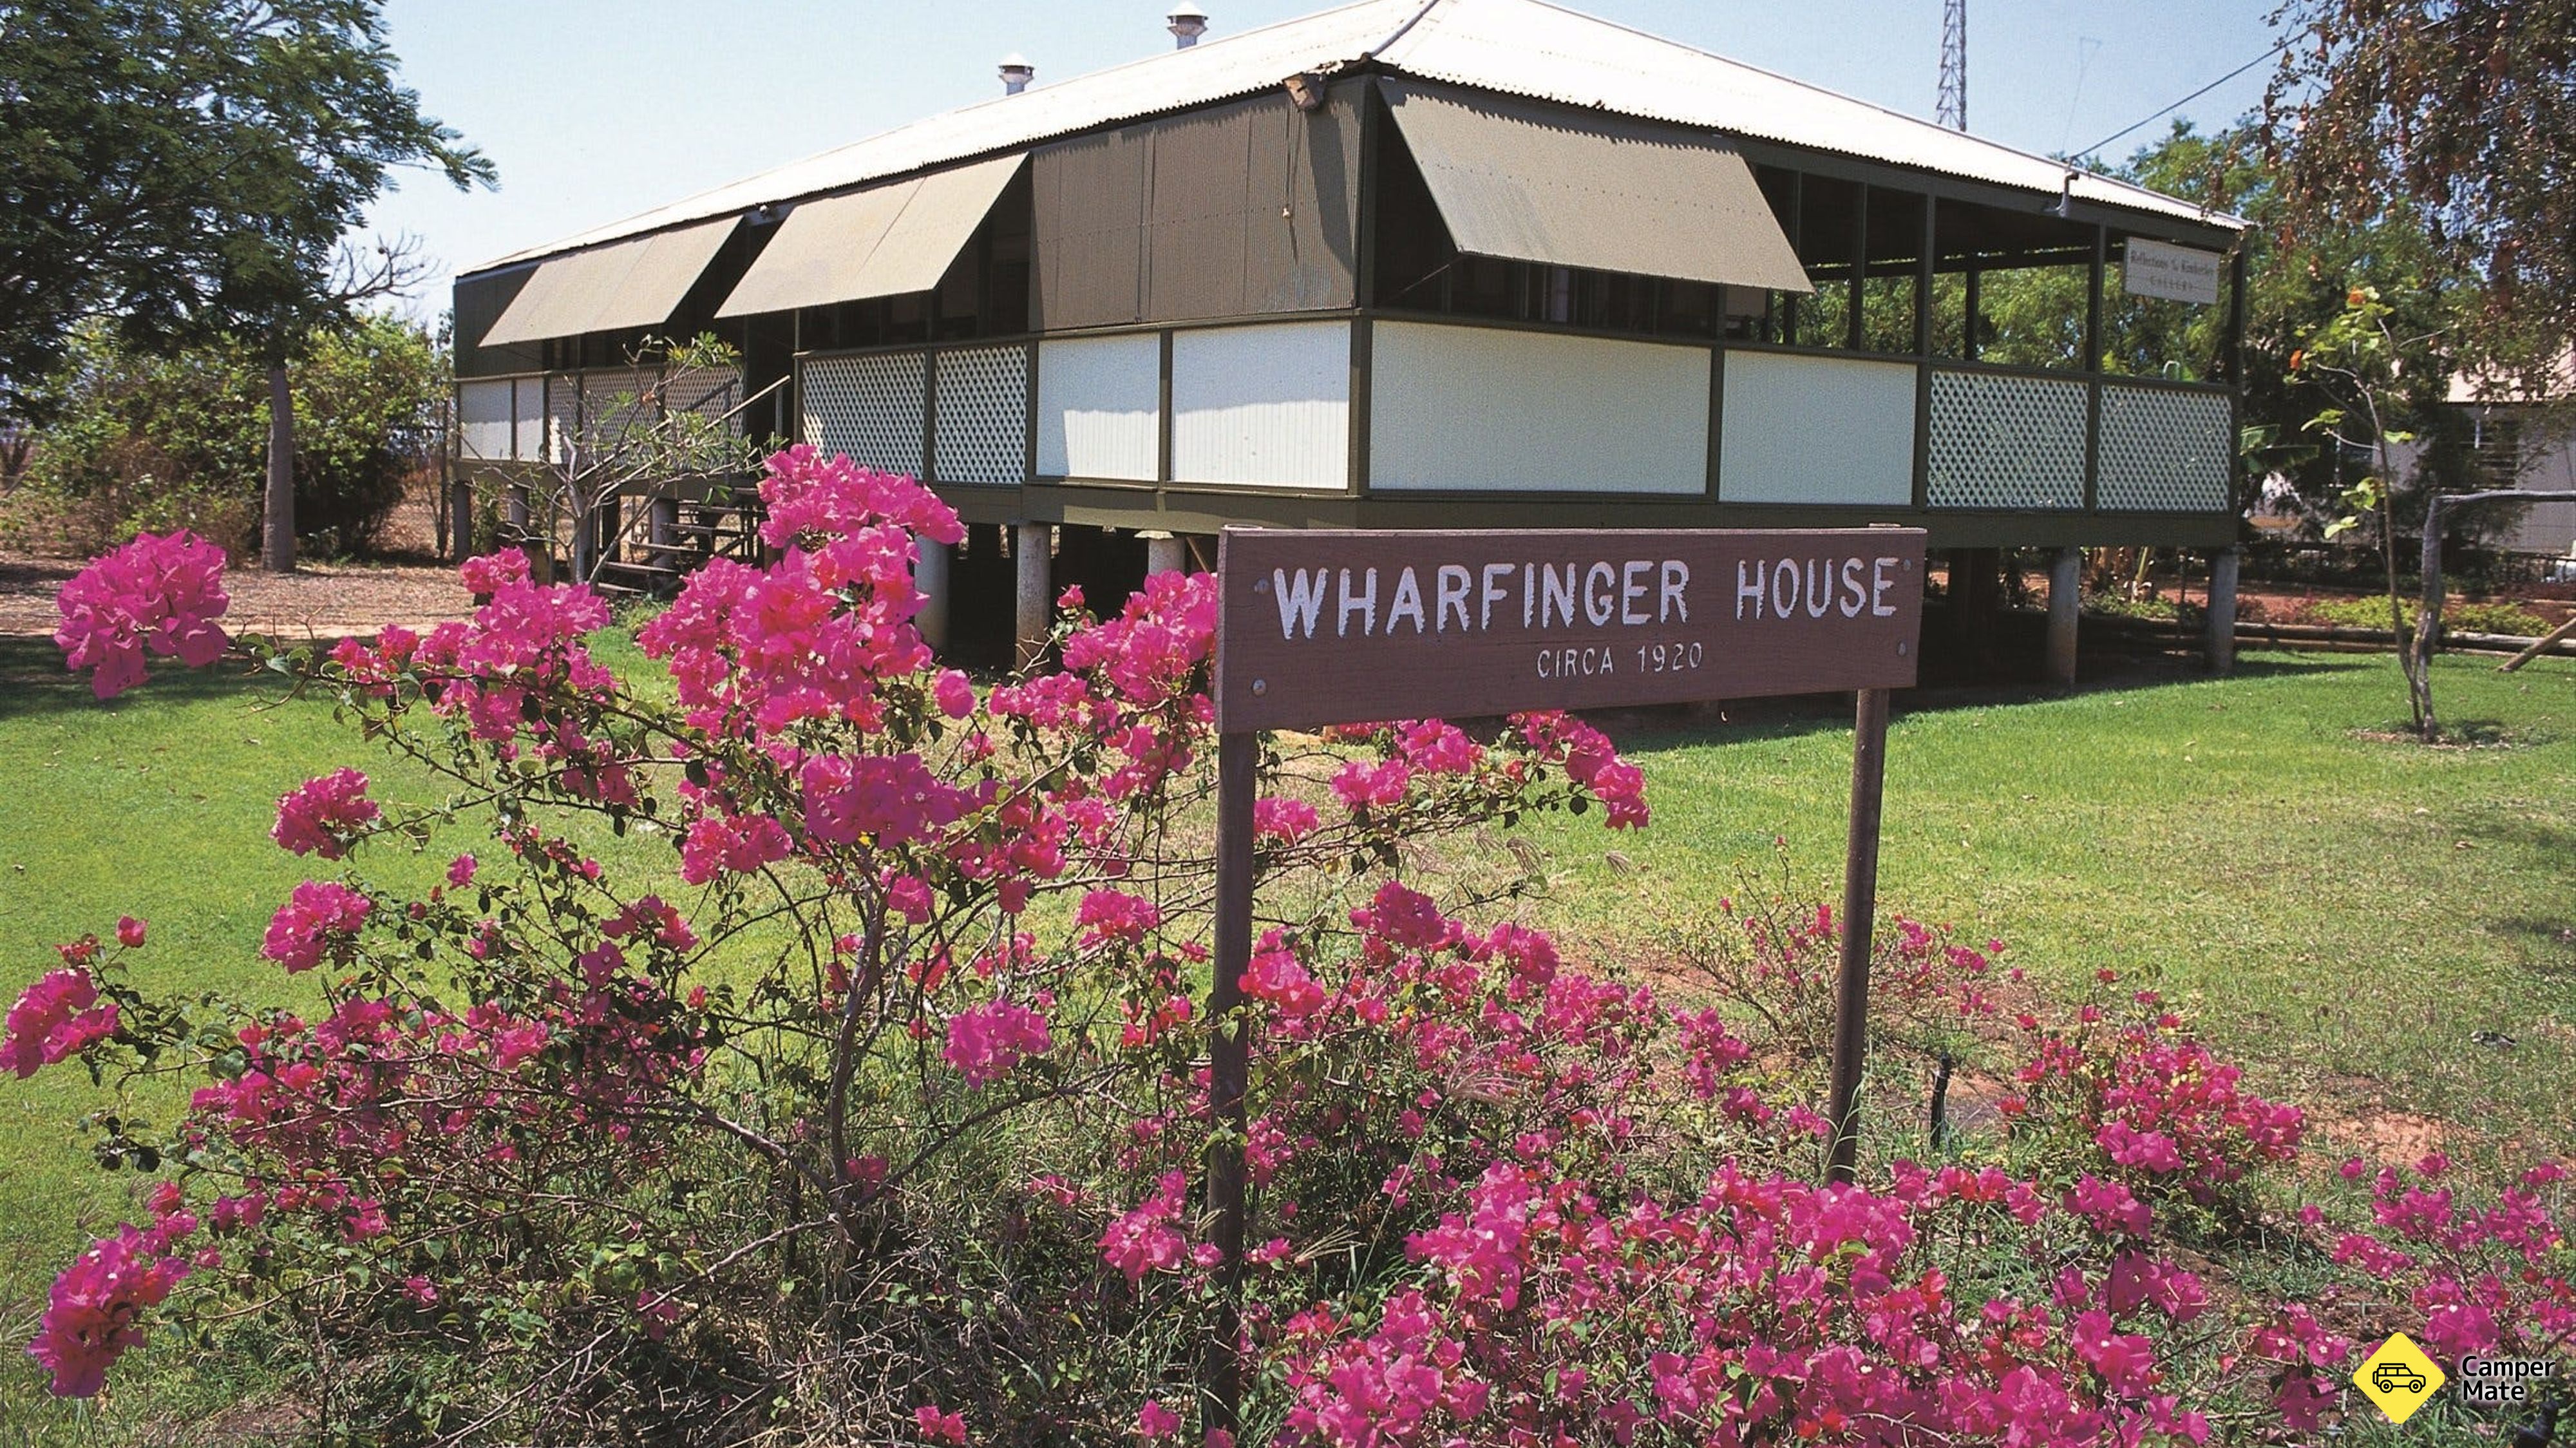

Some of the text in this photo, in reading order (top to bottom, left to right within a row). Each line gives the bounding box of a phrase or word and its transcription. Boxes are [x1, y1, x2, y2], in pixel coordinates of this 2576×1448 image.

[1273, 557, 1899, 640] WHARFINGER HOUSE
[1537, 642, 1703, 678] CIRCA 1920
